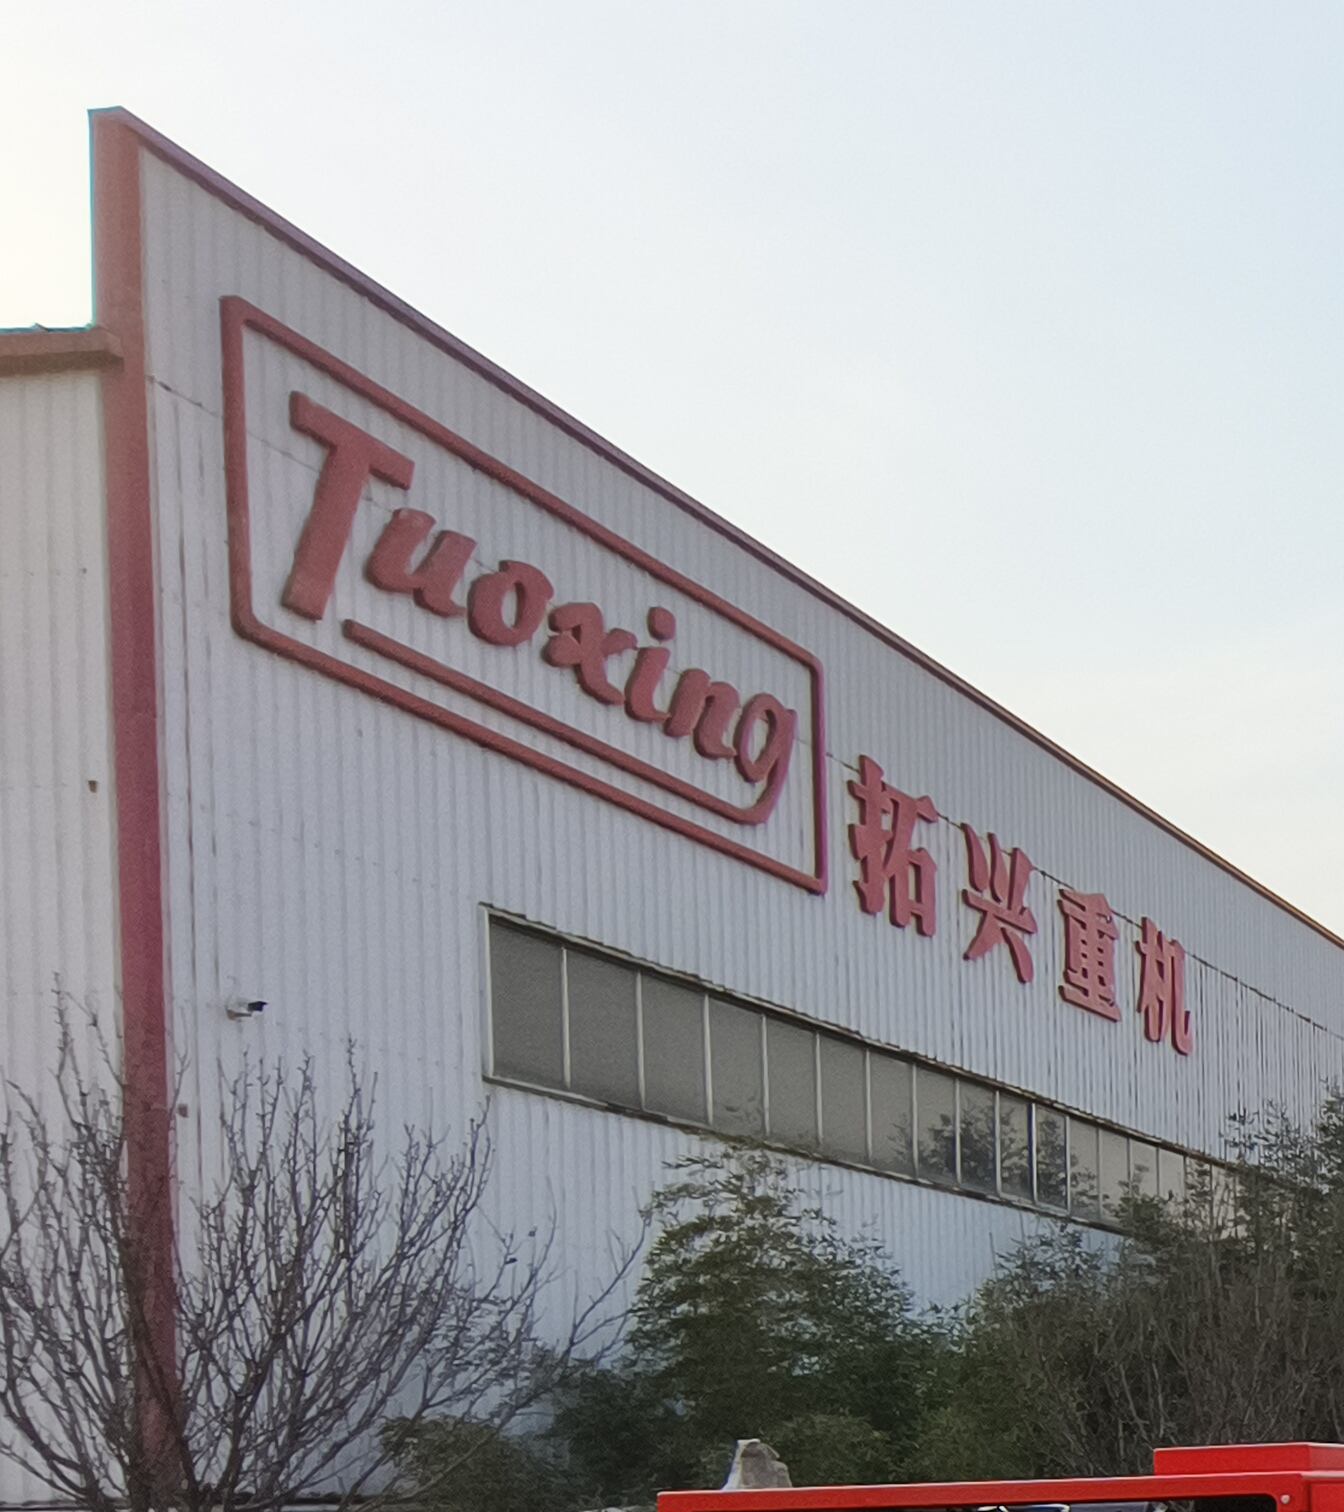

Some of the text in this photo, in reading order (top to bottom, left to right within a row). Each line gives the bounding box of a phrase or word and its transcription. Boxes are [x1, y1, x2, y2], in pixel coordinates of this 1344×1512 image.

[281, 390, 796, 824] Tuoxing
[847, 755, 1194, 1056] 拓兴重机
